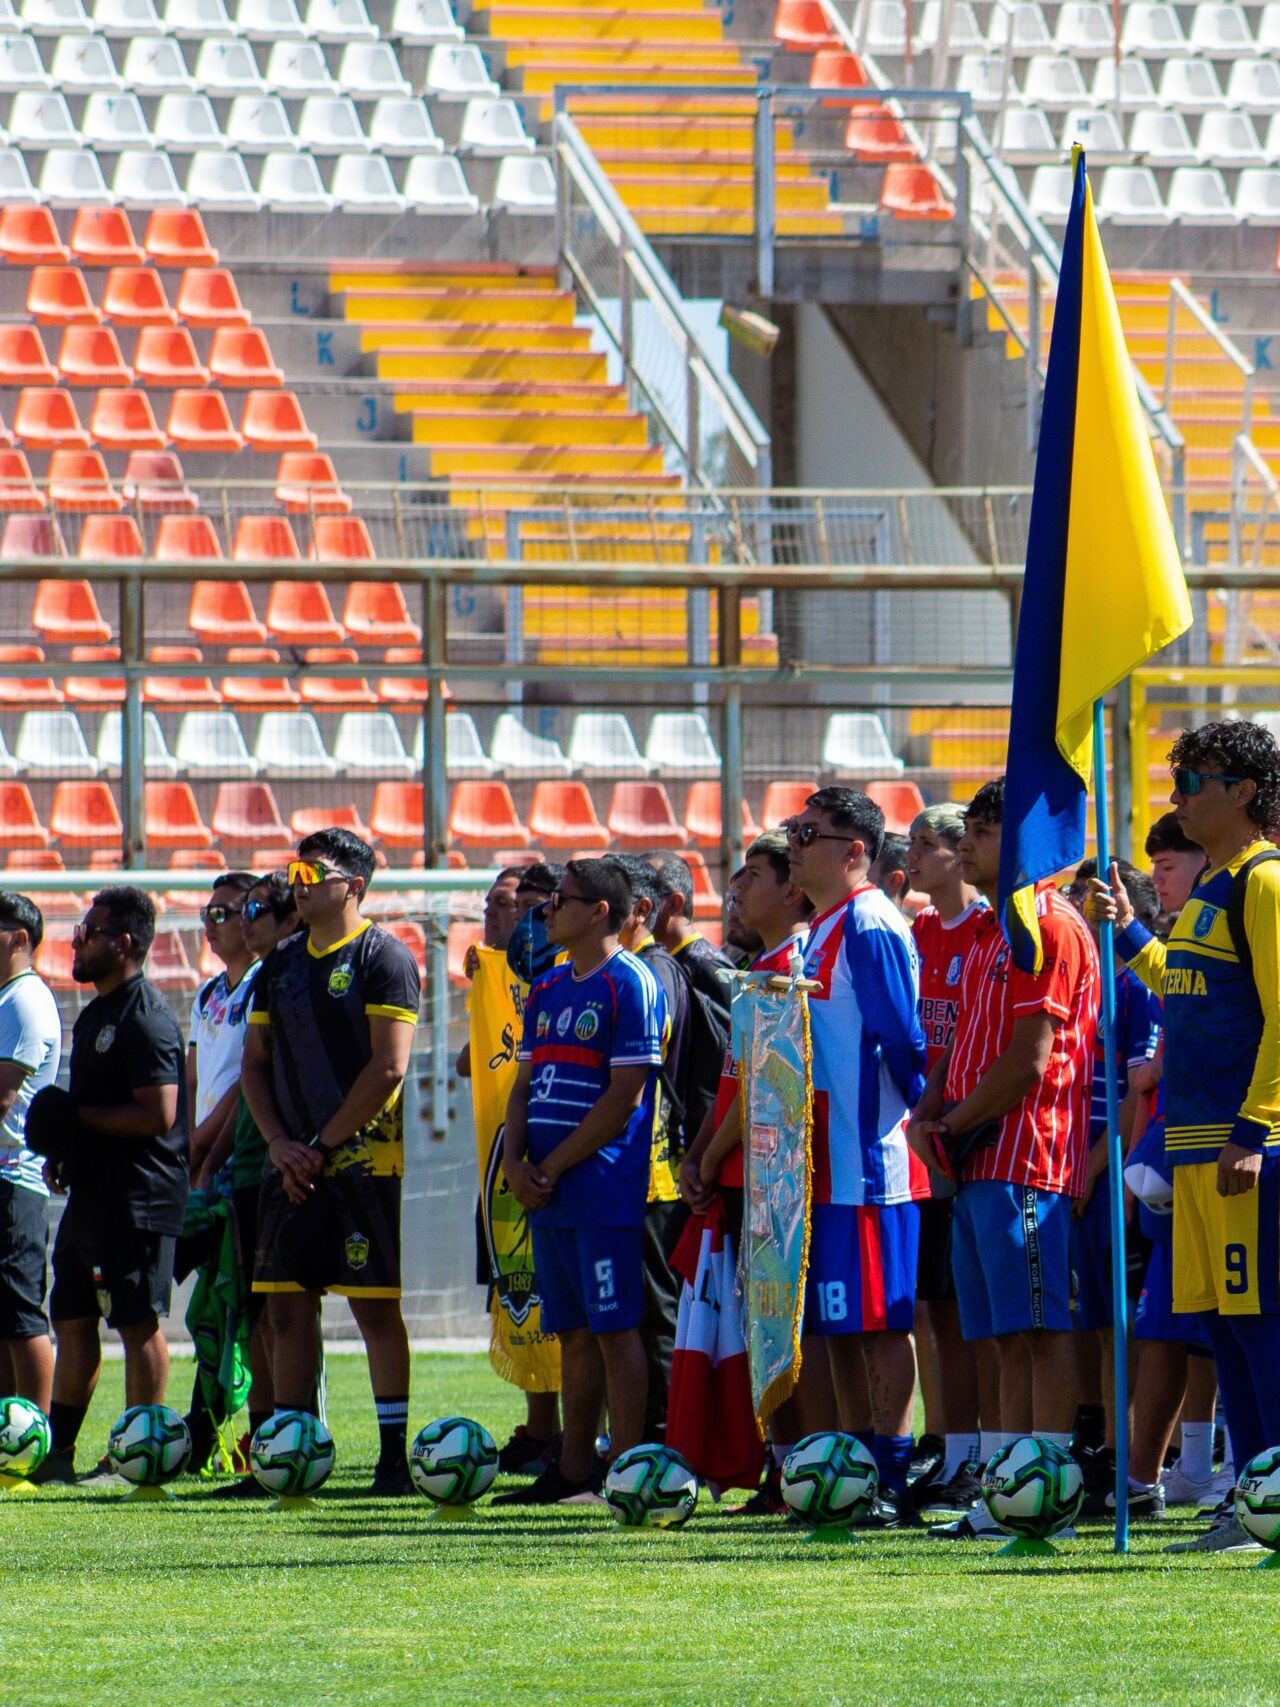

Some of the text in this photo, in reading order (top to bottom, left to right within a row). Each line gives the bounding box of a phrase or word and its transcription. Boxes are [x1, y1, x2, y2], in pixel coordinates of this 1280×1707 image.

[291, 281, 309, 314] L
[1211, 290, 1229, 323] L
[317, 331, 335, 366] K
[1255, 336, 1274, 371] K
[356, 397, 377, 432] J
[536, 1064, 556, 1100] 9
[1026, 1217, 1037, 1261] MICHAEL
[595, 1258, 616, 1298] 5
[1225, 1243, 1248, 1294] 9
[817, 1281, 848, 1322] 18
